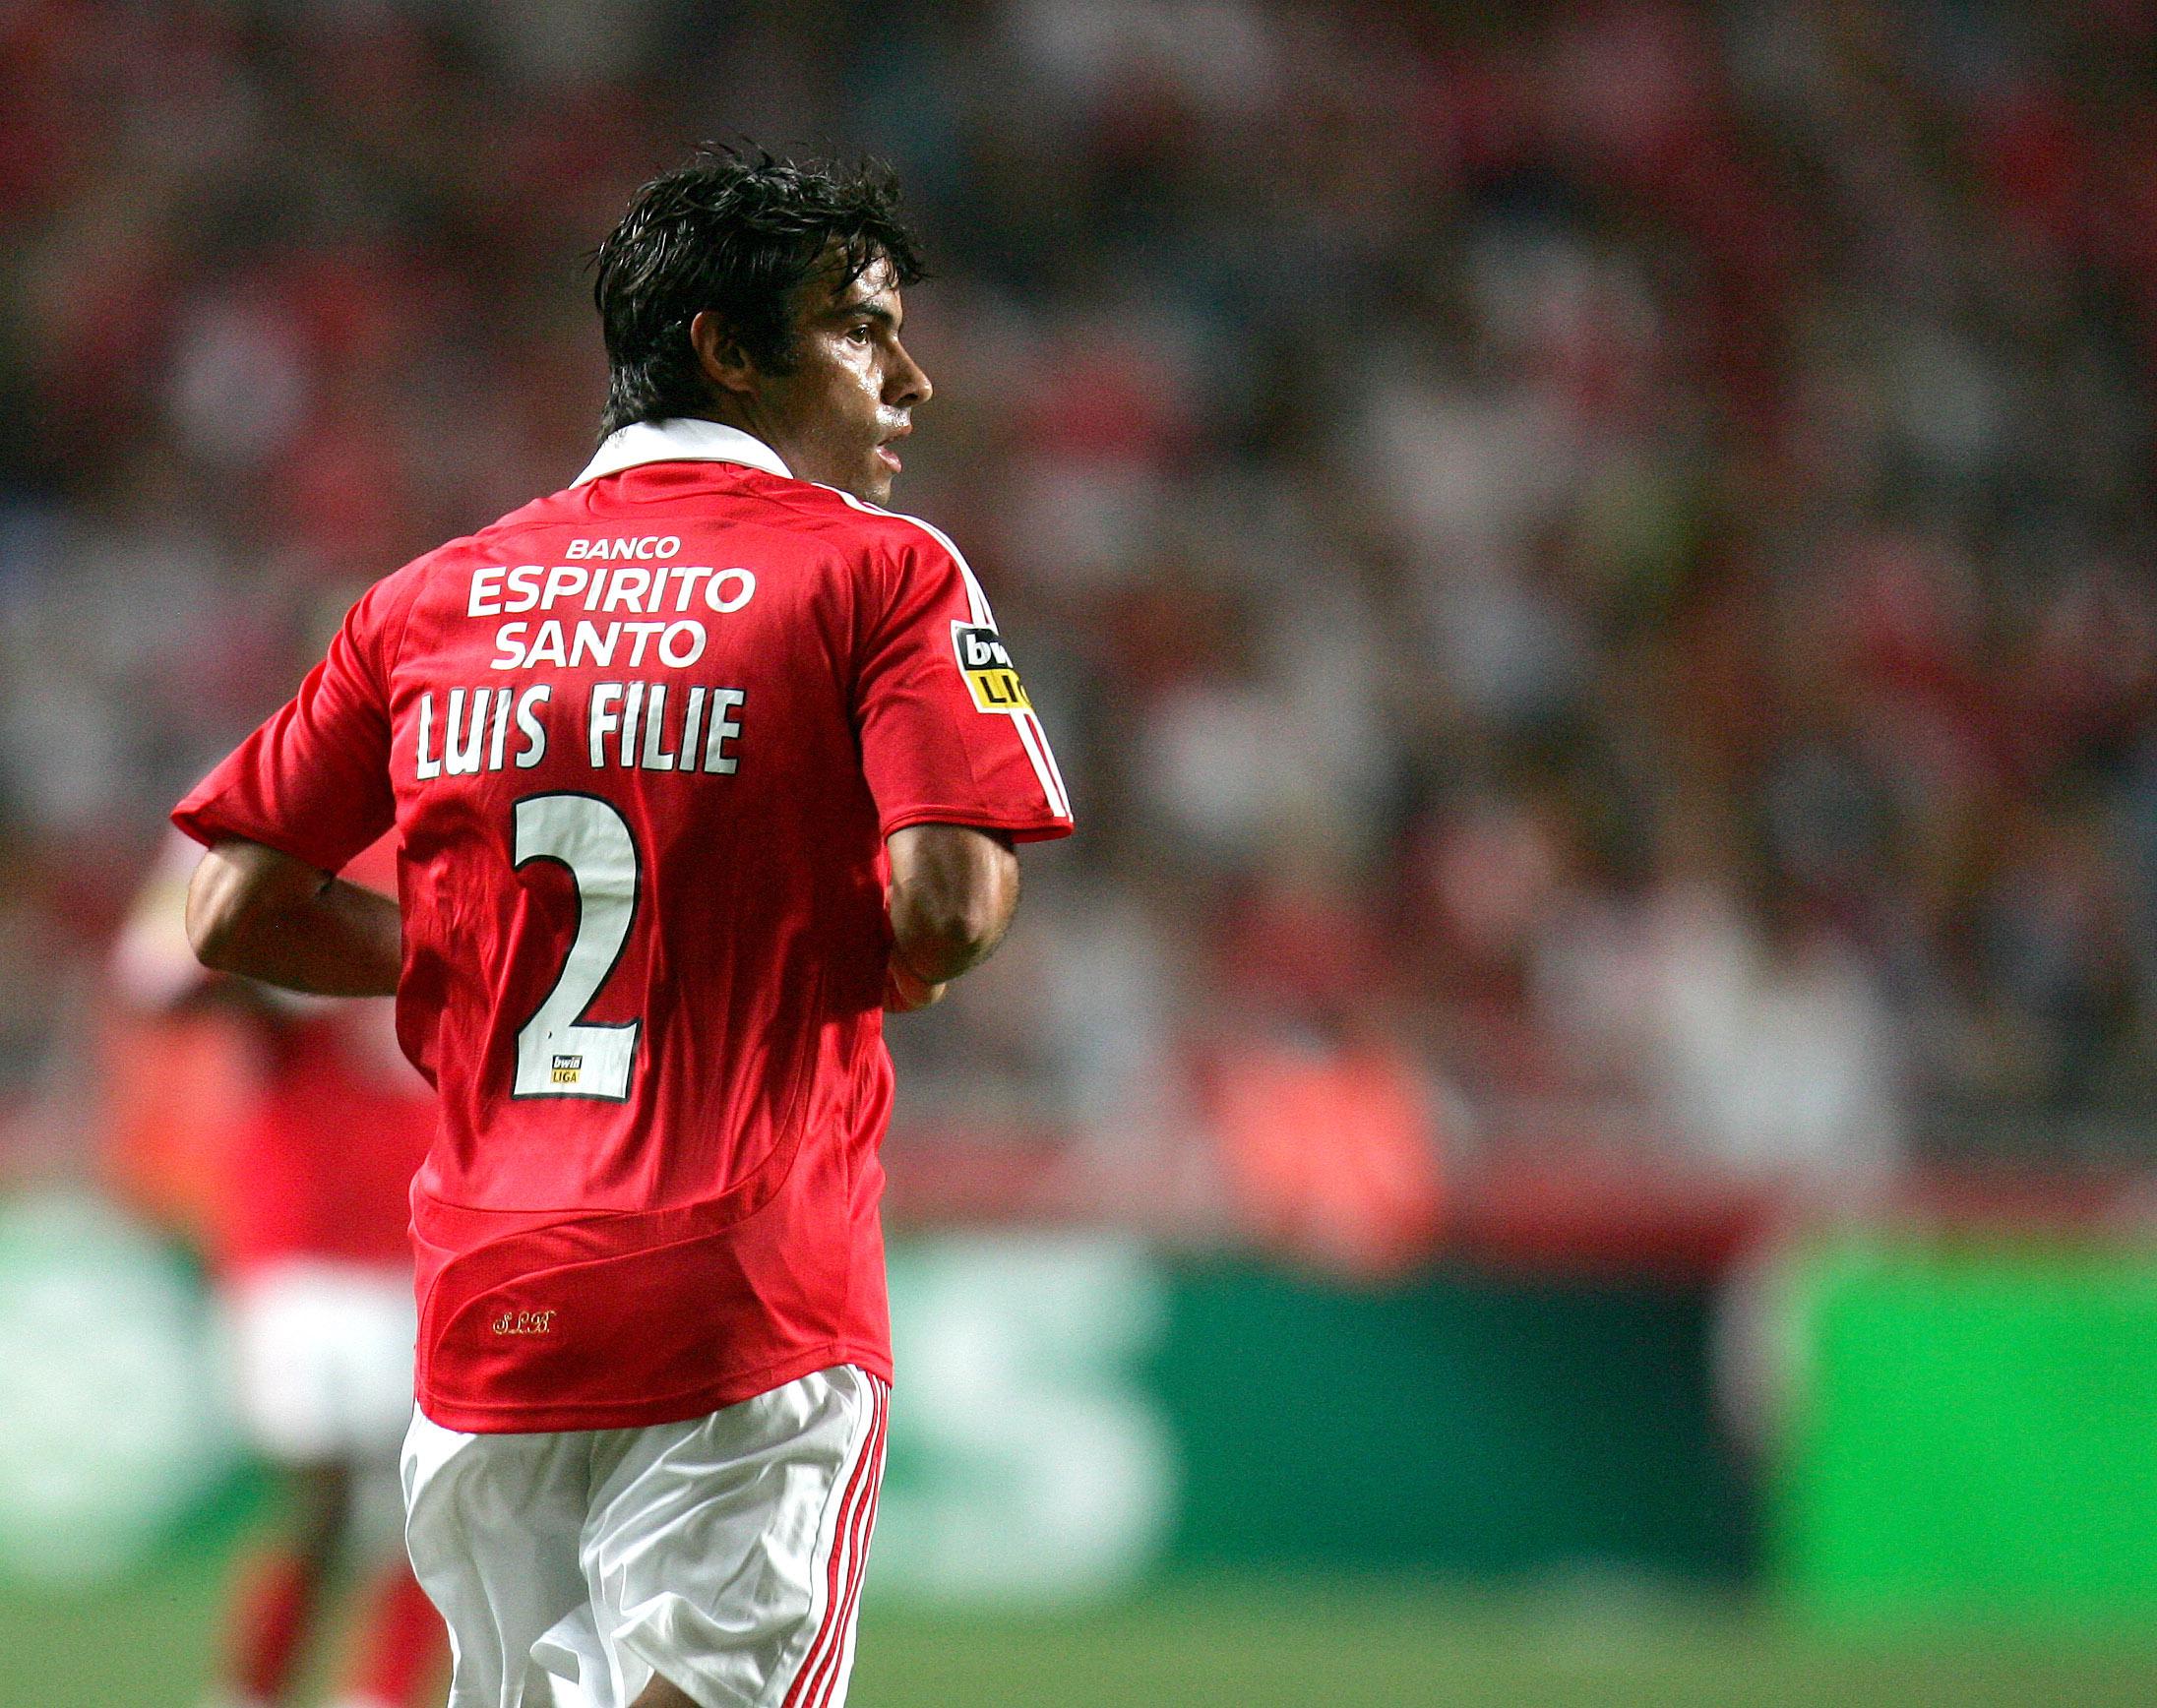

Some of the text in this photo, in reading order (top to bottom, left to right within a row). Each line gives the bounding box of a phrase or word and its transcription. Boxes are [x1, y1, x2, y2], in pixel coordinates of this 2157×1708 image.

[565, 536, 681, 560] BANCO
[467, 566, 757, 618] ESPIRITO
[490, 620, 708, 670] SANTO
[965, 634, 1014, 669] bw
[416, 681, 745, 780] LUIS FILIE
[512, 791, 641, 1102] 2
[553, 1070, 577, 1083] LIGA
